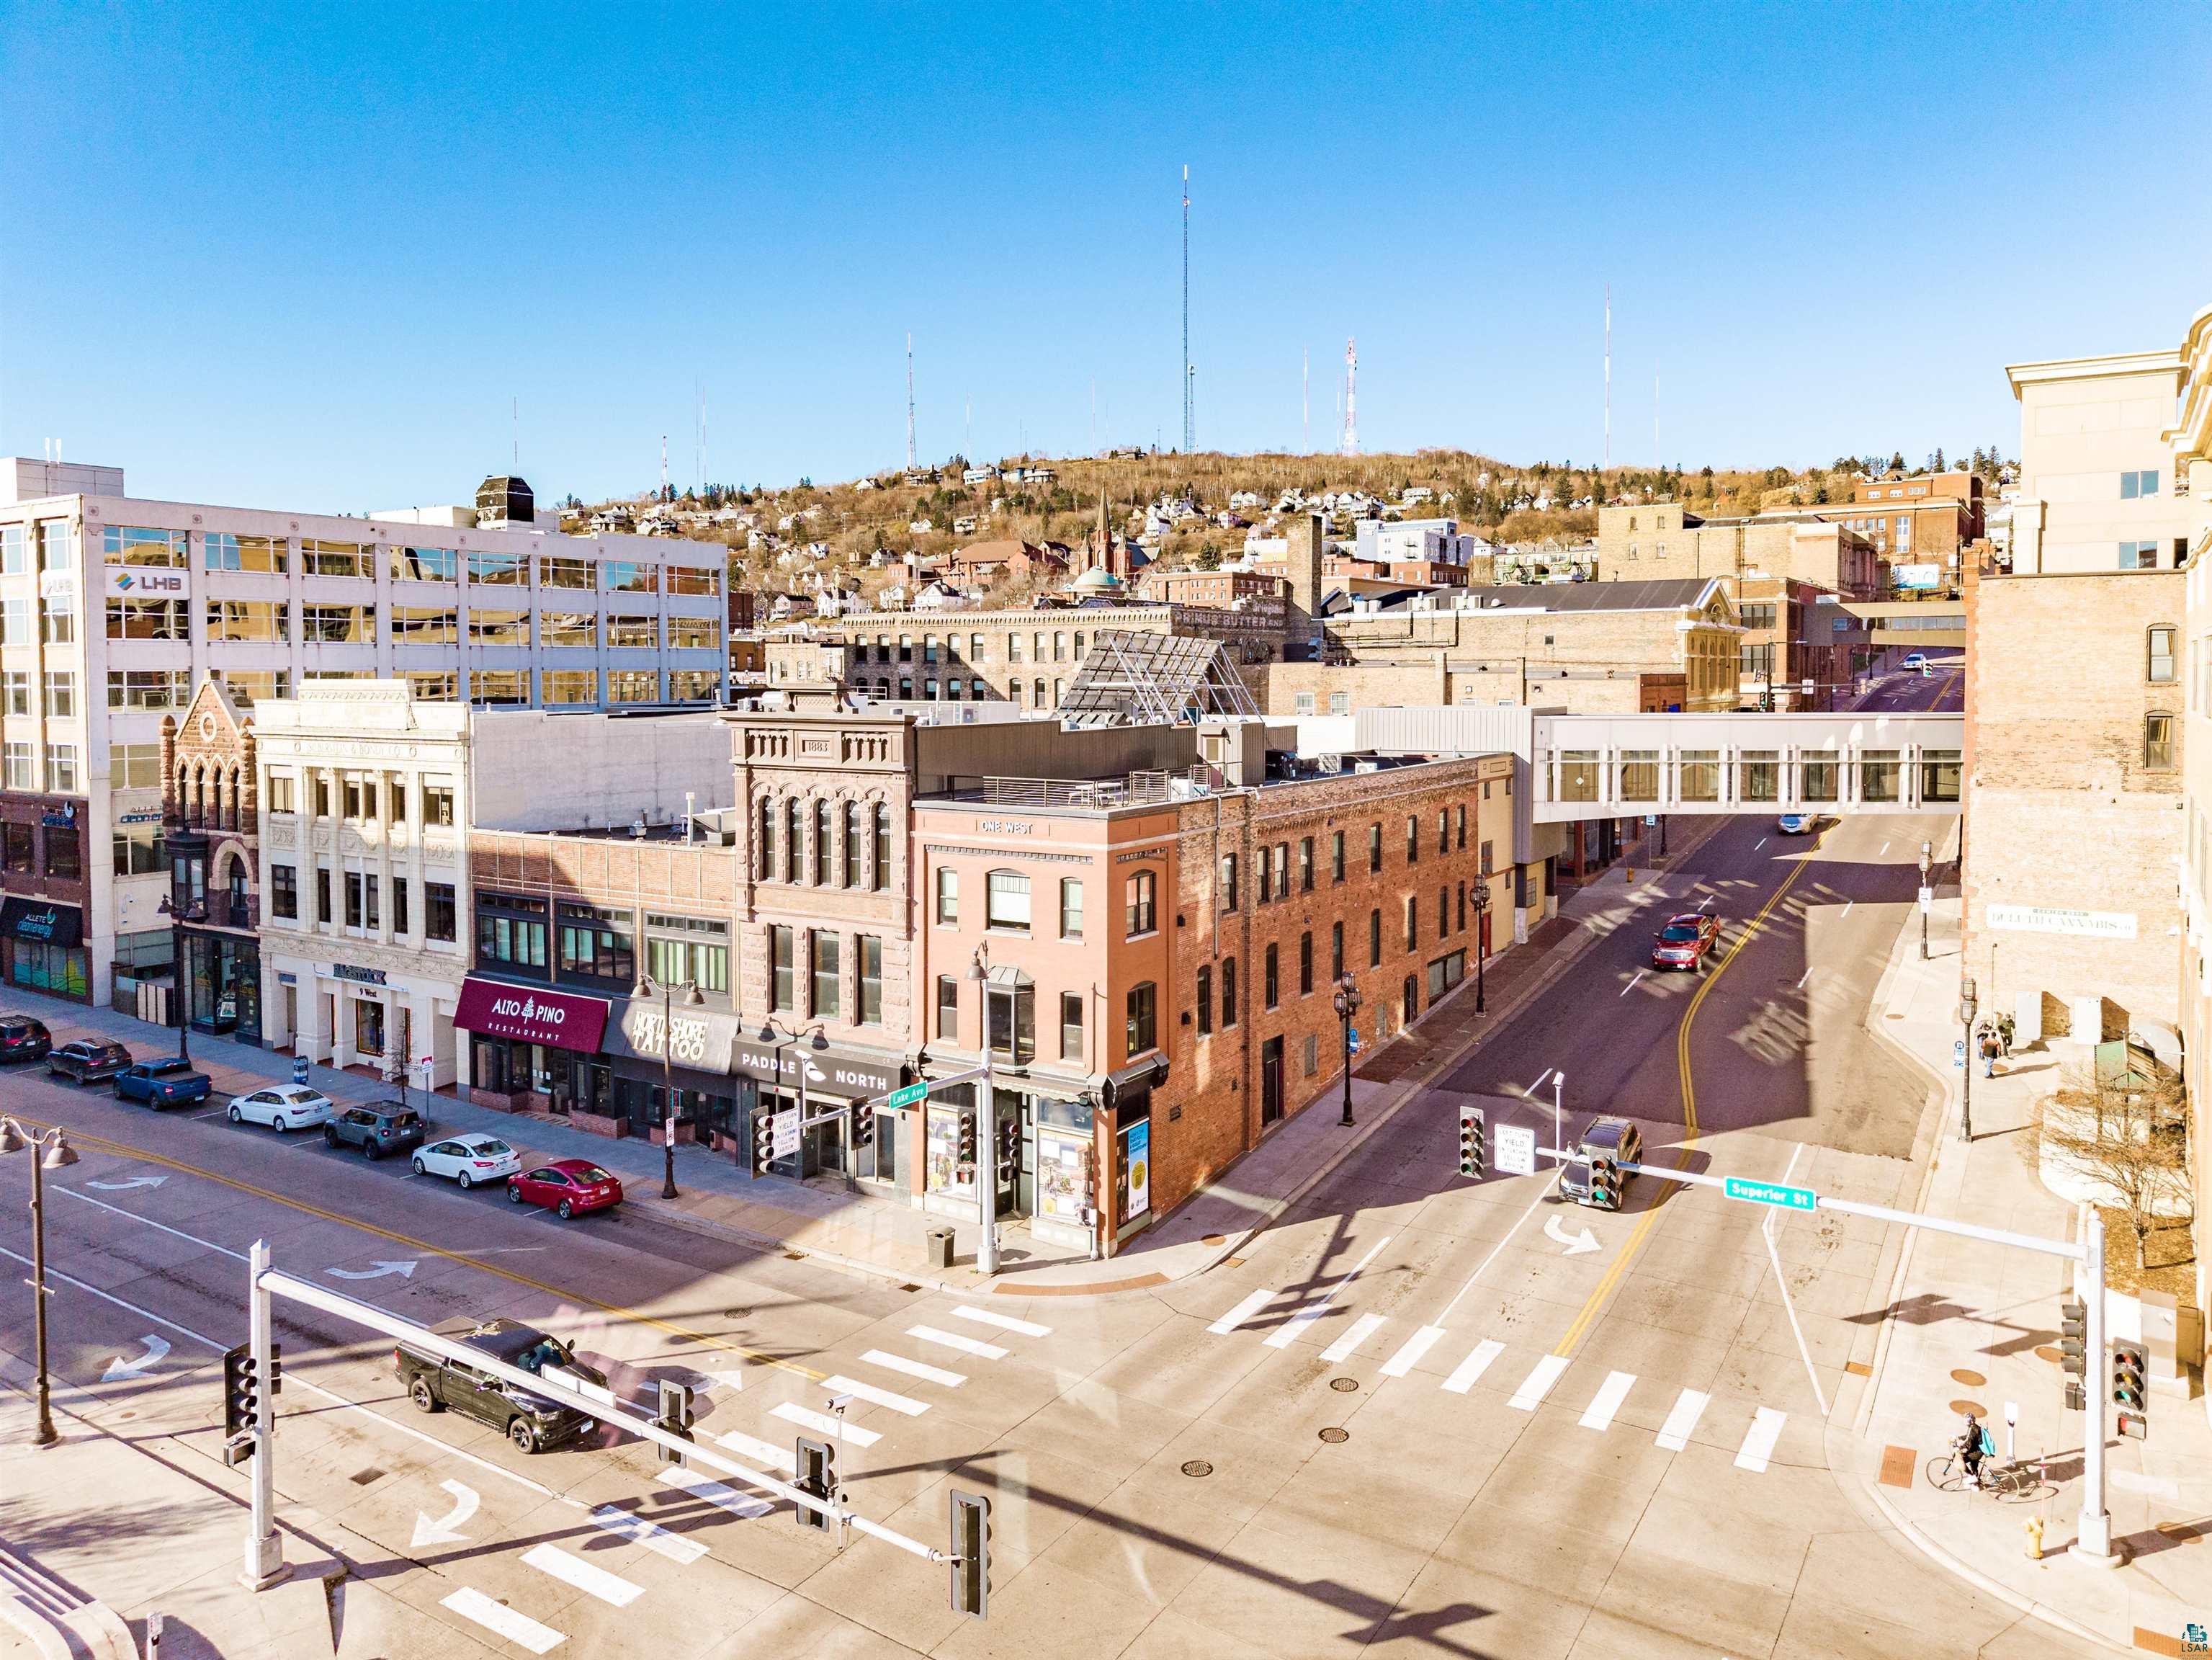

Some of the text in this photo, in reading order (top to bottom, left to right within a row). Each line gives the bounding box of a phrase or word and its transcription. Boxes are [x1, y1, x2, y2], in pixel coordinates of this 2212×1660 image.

[140, 576, 182, 591] LHB
[1223, 615, 1266, 627] BUTTER
[808, 741, 828, 753] 1883
[980, 821, 1033, 834] ONE WEST
[25, 914, 47, 924] ALLETE
[2048, 917, 2118, 931] CANNABIS
[333, 963, 387, 986] RAGSTOCK
[365, 989, 377, 998] West
[491, 998, 565, 1025] ALTO PINO
[488, 1022, 560, 1041] RESTAURANT
[670, 1017, 709, 1043] SHORE
[632, 1030, 704, 1061] TATTOO
[742, 1053, 887, 1091] PADDLE NORTH
[893, 1087, 924, 1105] Lake Ave
[1505, 1138, 1525, 1147] YIELD
[1732, 1182, 1809, 1205] Superior St
